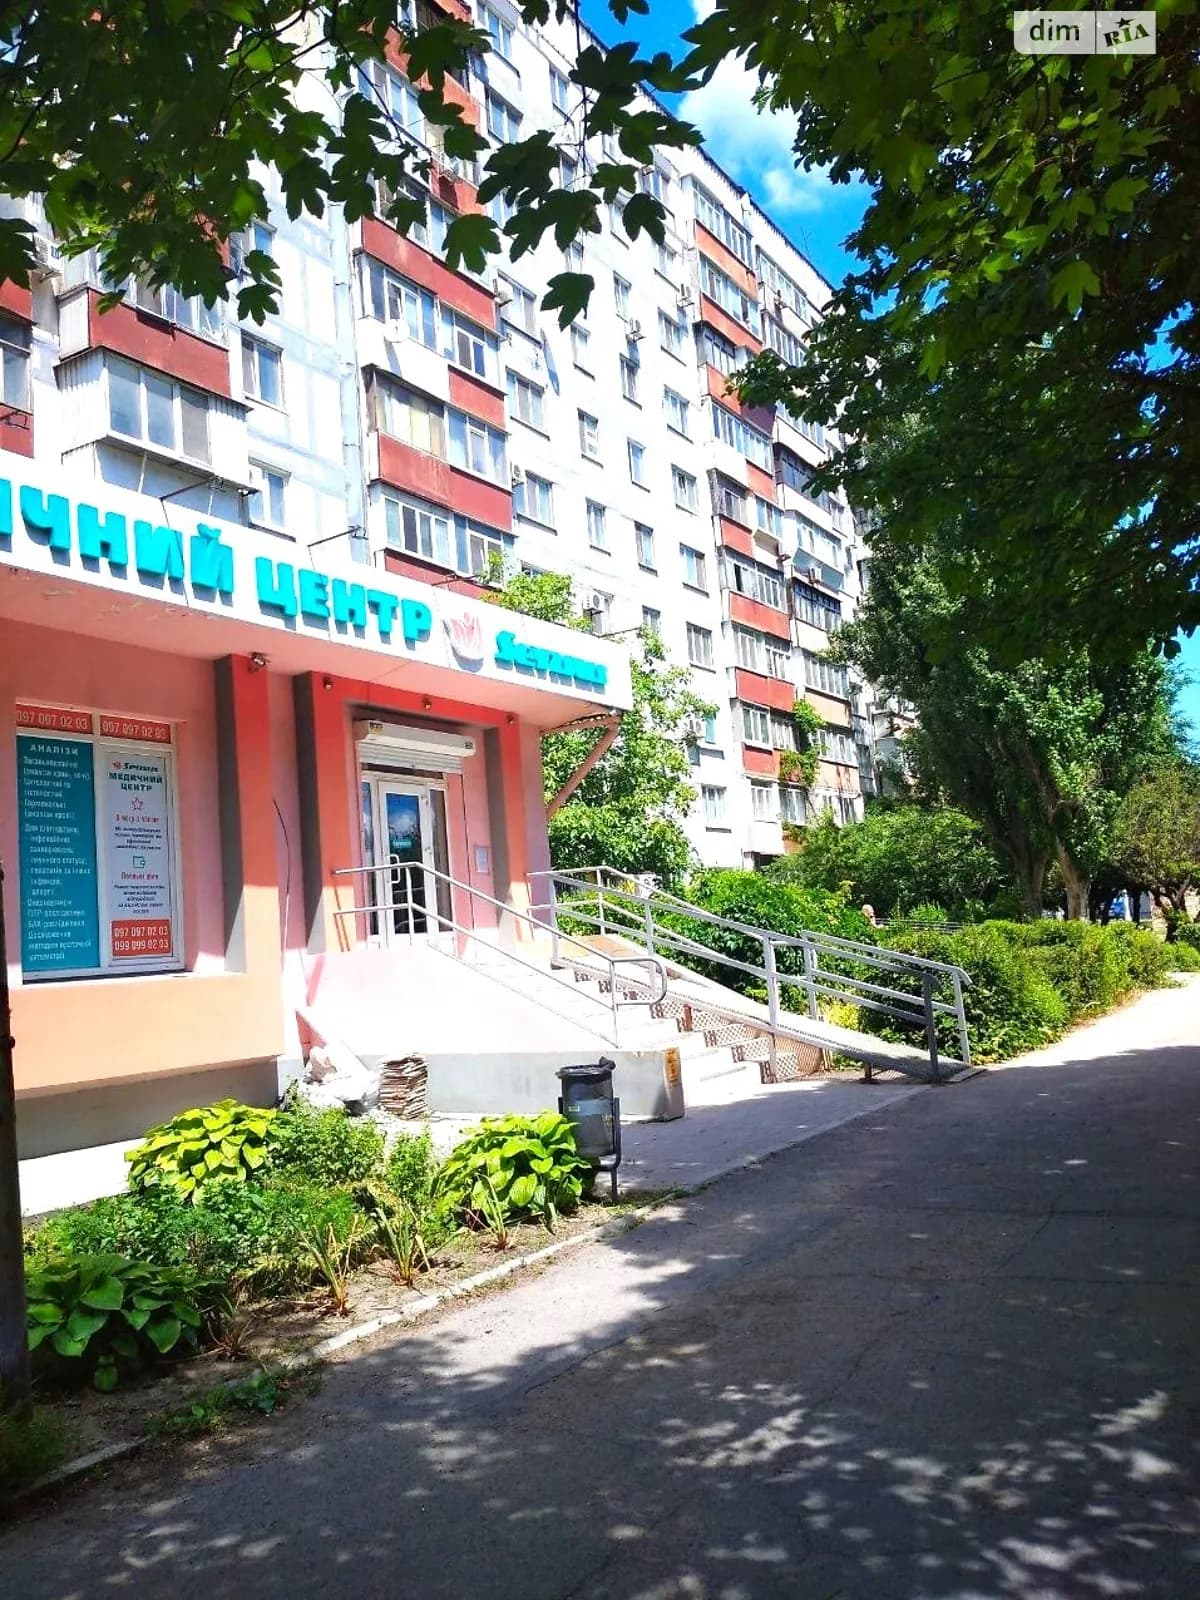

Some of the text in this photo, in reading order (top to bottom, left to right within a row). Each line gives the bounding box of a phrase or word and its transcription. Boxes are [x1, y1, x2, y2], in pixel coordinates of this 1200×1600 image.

[0, 478, 234, 594] ЧНИЙ
[255, 556, 432, 642] ЦЕНТР
[38, 713, 57, 726] 097
[60, 715, 73, 729] 02
[75, 717, 88, 730] 03
[102, 720, 119, 735] 097
[122, 722, 139, 736] 097
[30, 743, 79, 756] АНАЛІЗИ
[109, 772, 163, 784] МЕДИЧНИЙ
[121, 783, 152, 792] ЦЕНТР
[114, 925, 168, 937] 097 097 02 03
[114, 940, 130, 951] 099
[131, 940, 146, 951] 099
[147, 939, 158, 949] 02
